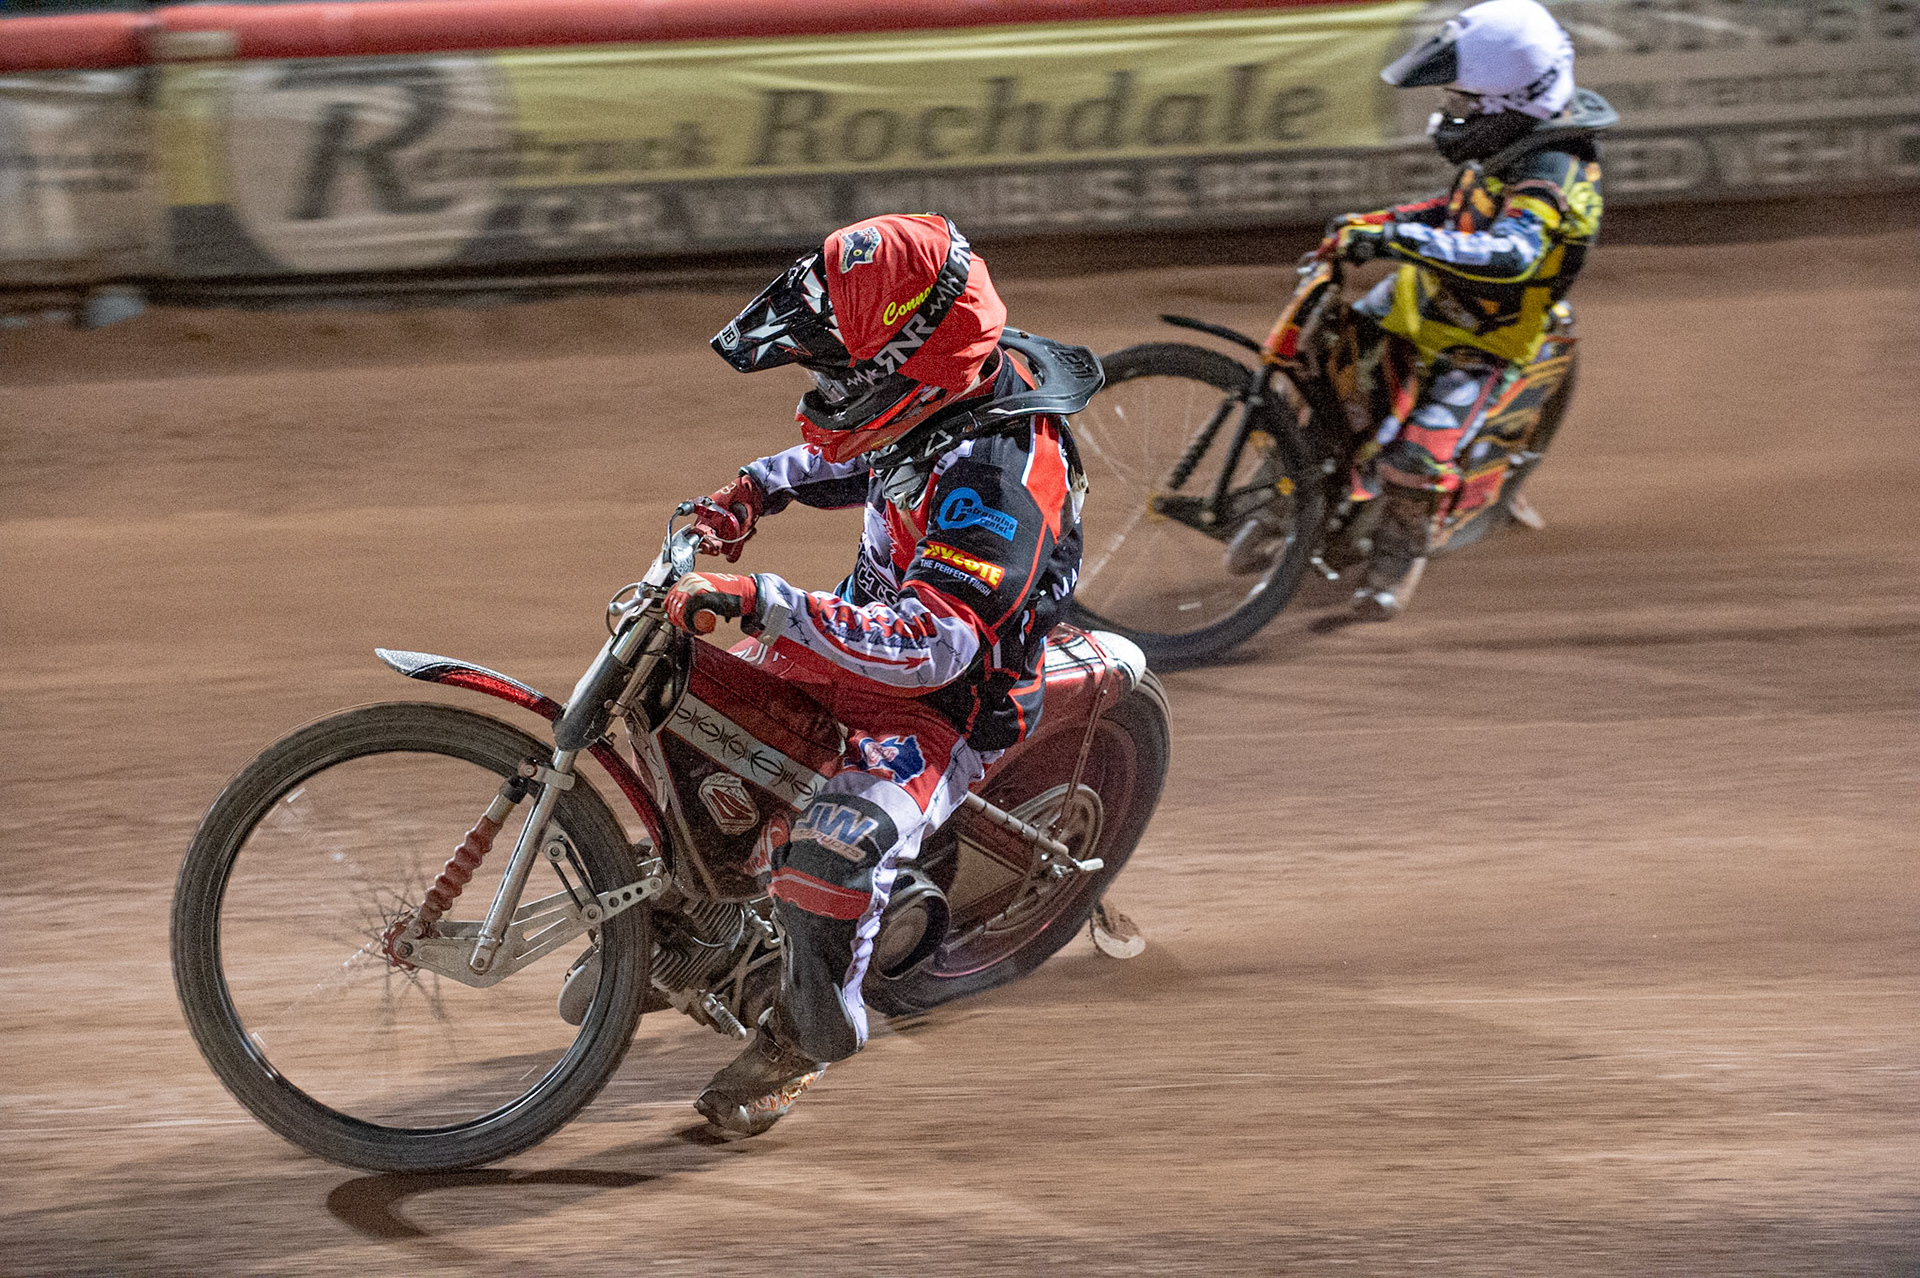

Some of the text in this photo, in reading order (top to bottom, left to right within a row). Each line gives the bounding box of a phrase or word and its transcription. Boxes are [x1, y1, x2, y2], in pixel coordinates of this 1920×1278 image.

[748, 63, 1328, 167] Rochdale
[882, 284, 935, 326] Conno
[920, 558, 992, 597] THE PERFECT FINISH
